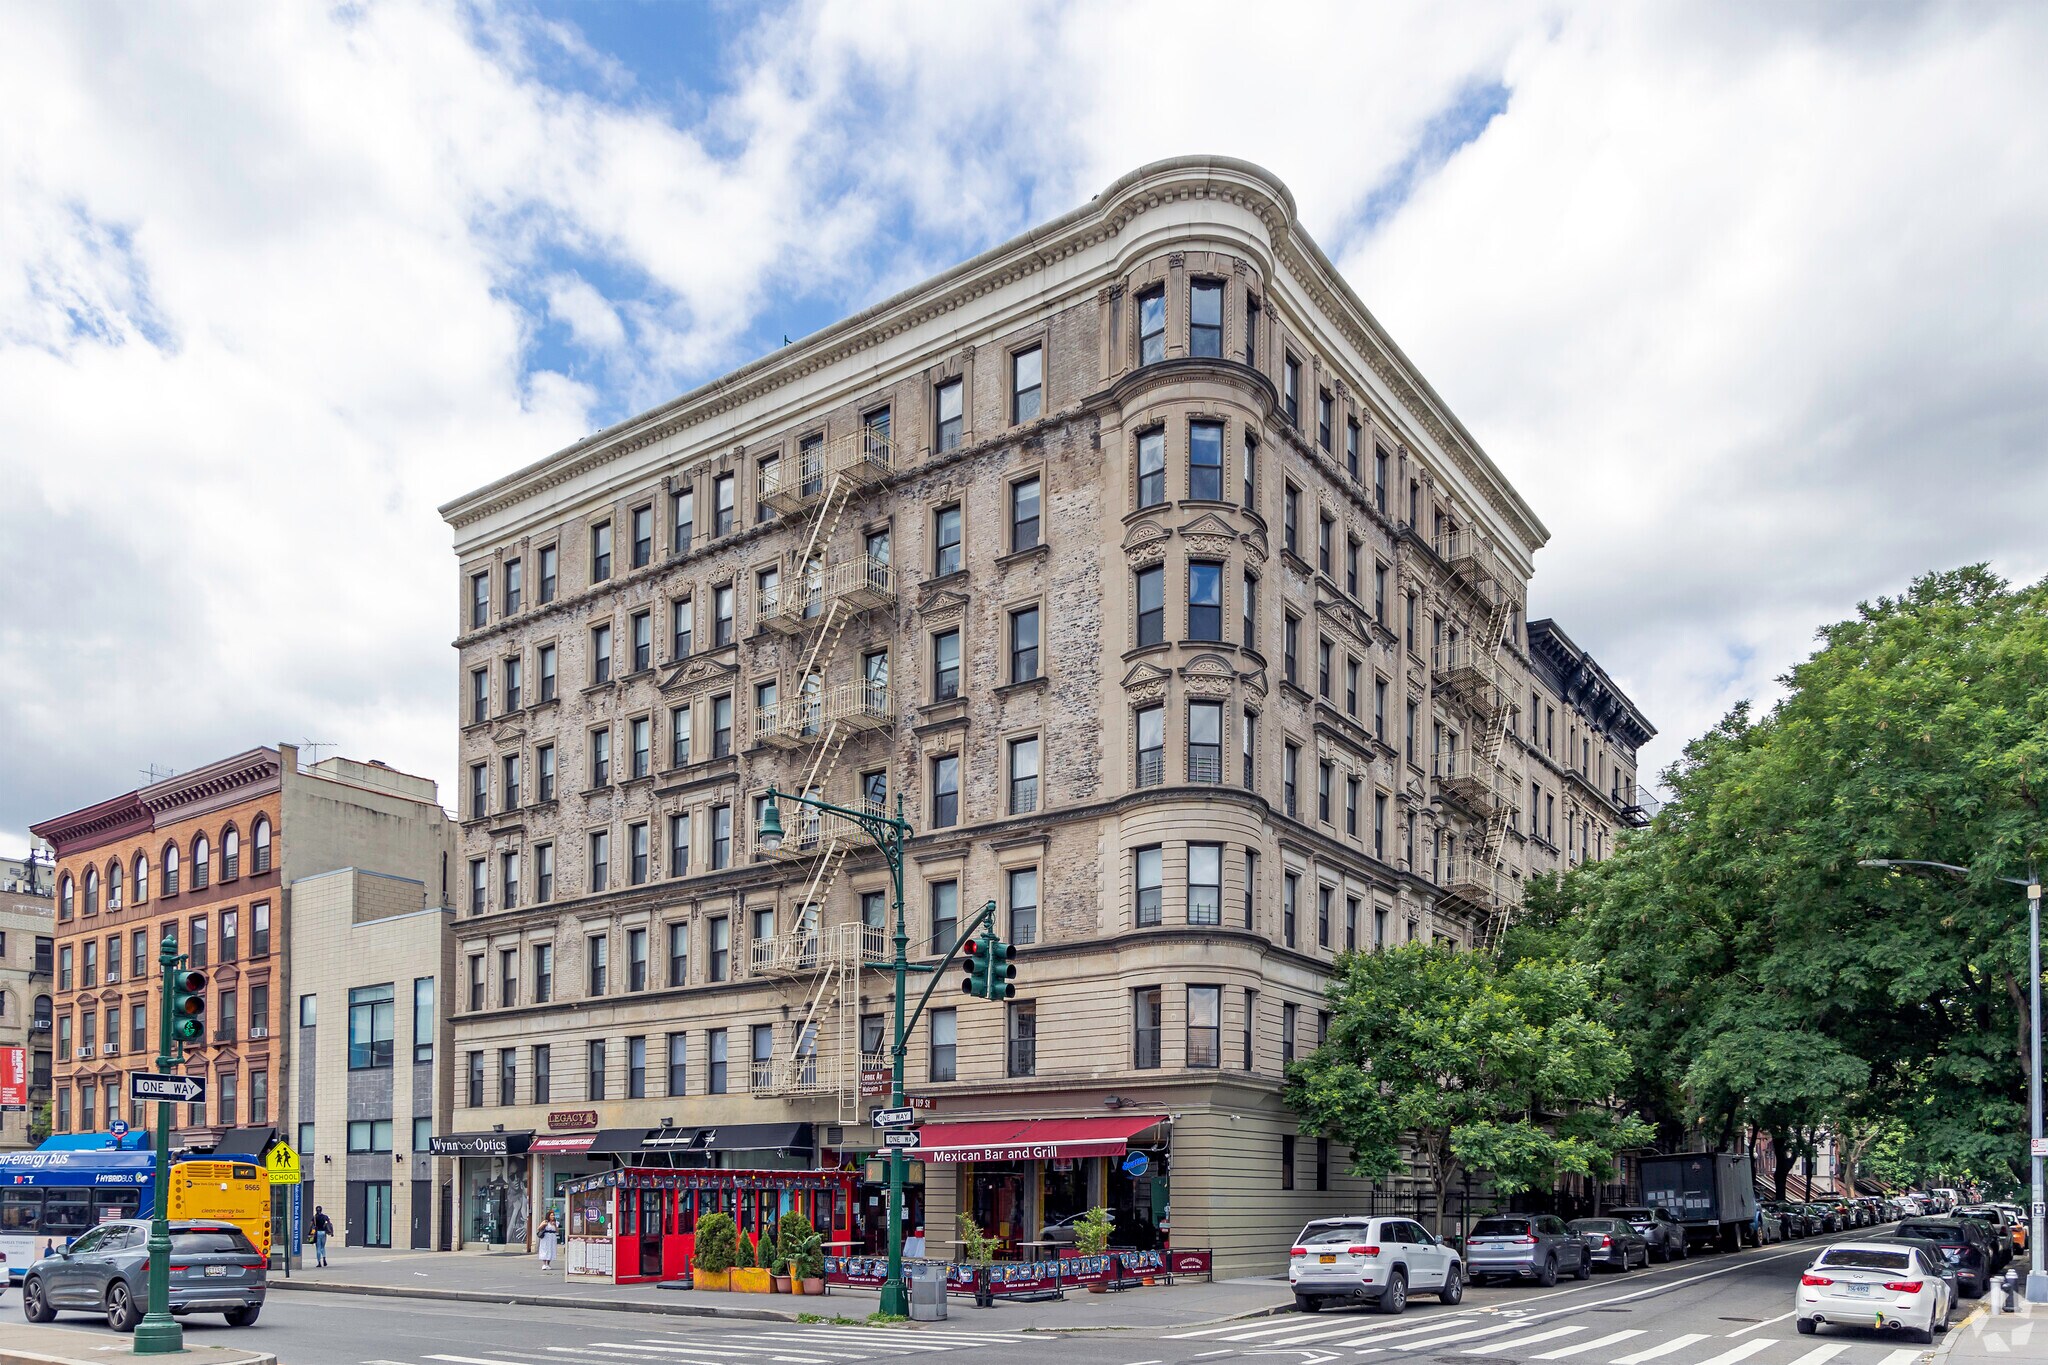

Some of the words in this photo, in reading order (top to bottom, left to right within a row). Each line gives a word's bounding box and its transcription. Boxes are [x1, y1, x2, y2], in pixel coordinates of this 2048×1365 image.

[862, 1073, 875, 1081] Lenox
[142, 1081, 164, 1093] ONE
[174, 1083, 195, 1095] WAY
[915, 1098, 923, 1107] 119
[924, 1099, 930, 1108] St
[549, 1113, 585, 1122] LEGACY
[879, 1114, 890, 1122] ONE
[432, 1138, 459, 1153] Wynn
[475, 1138, 507, 1153] Optics
[48, 1152, 70, 1165] bus
[933, 1150, 981, 1162] Mexican
[984, 1149, 1003, 1160] Bar
[1007, 1147, 1029, 1159] and
[1033, 1146, 1057, 1158] Grill
